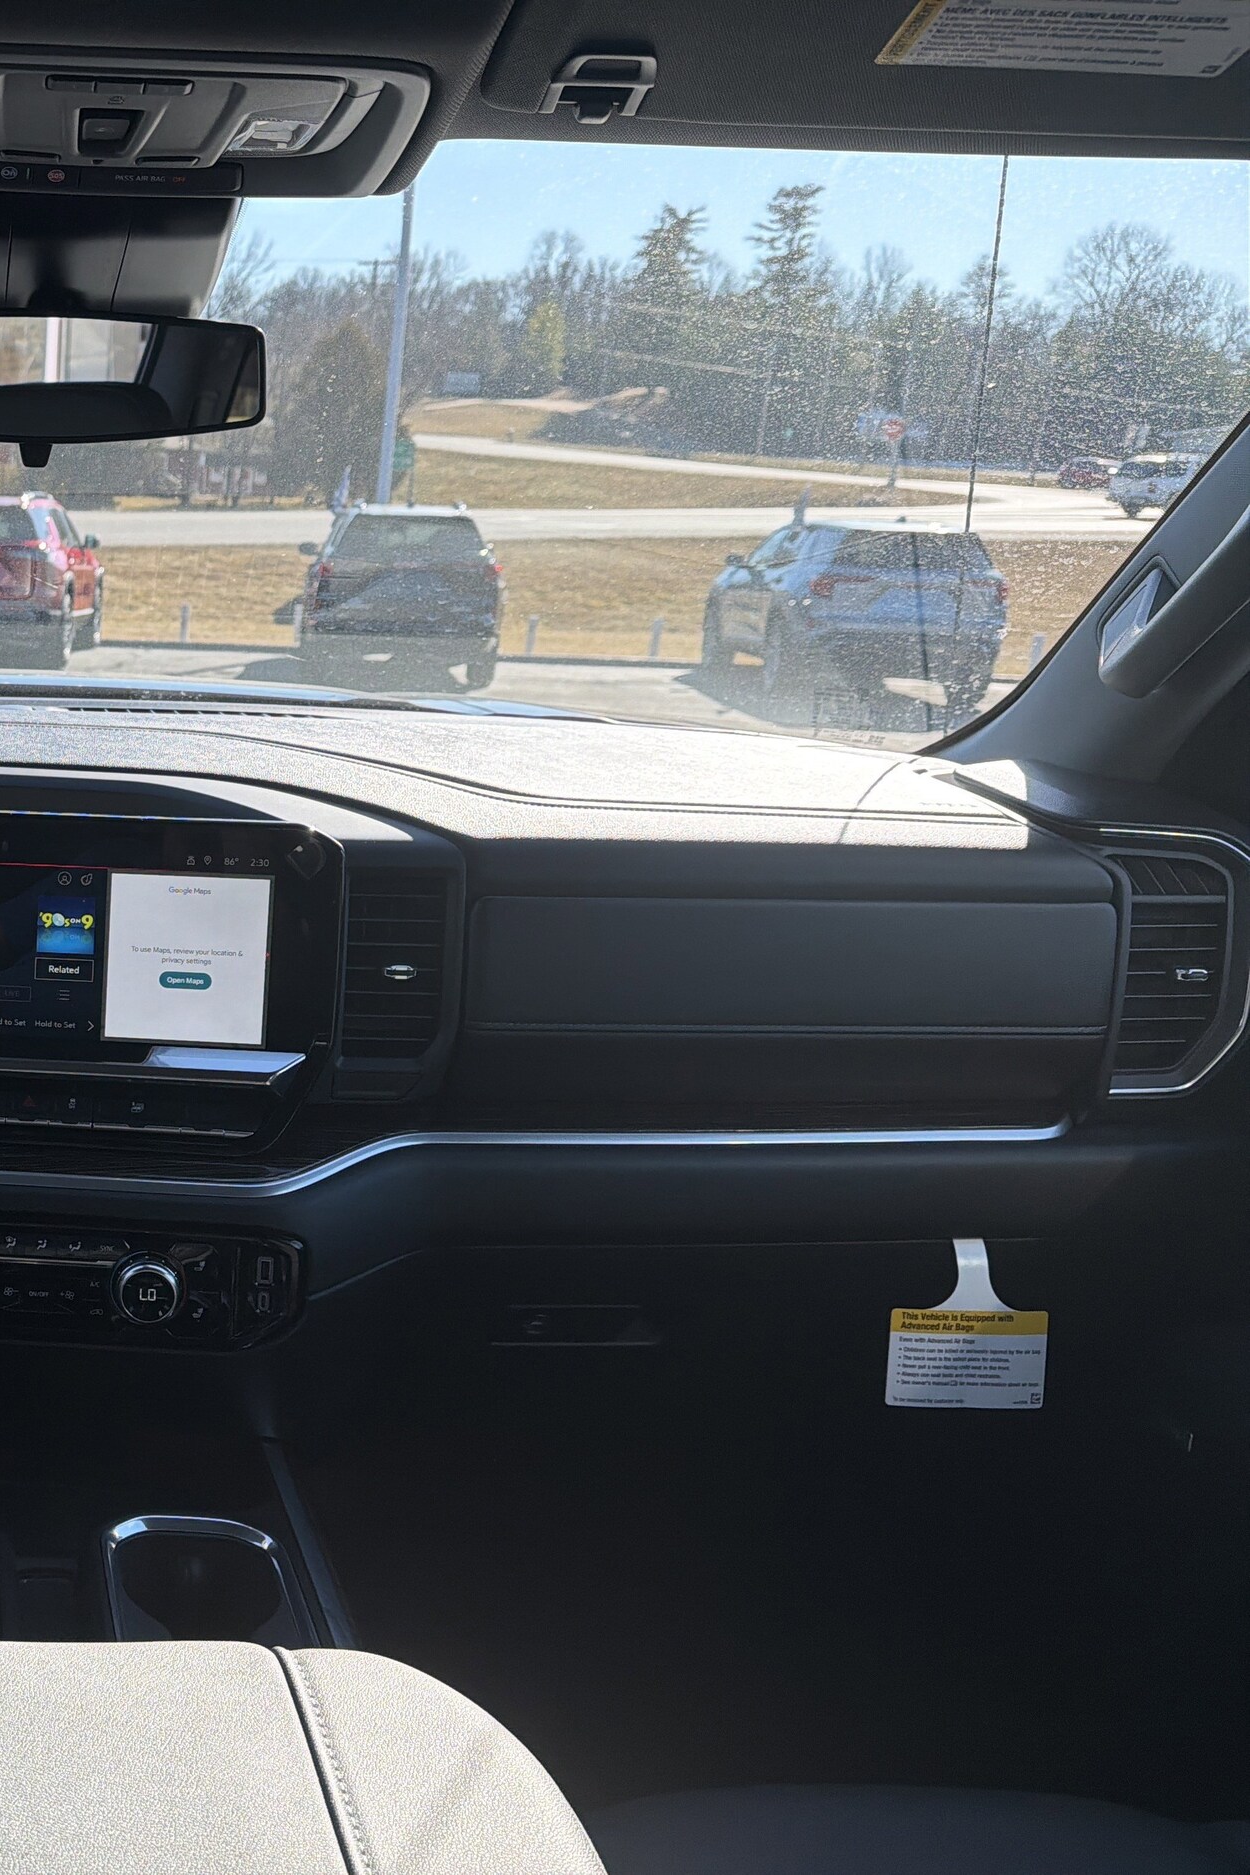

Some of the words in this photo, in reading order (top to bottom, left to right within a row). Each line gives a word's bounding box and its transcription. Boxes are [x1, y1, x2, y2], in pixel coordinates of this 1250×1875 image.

[250, 858, 270, 867] 2:30
[168, 886, 193, 896] Google
[81, 914, 94, 930] 9
[153, 946, 172, 954] Maps,
[211, 949, 237, 957] location
[161, 957, 185, 965] privacy
[186, 958, 212, 966] settings
[48, 965, 80, 974] Related
[166, 976, 185, 985] Open
[186, 977, 204, 985] Maps
[14, 1019, 26, 1027] Set
[34, 1020, 55, 1028] Hold
[64, 1021, 76, 1030] Set
[139, 1288, 157, 1302] LO
[902, 1312, 919, 1320] This
[921, 1312, 949, 1321] Vehicle
[960, 1314, 996, 1324] Equipped
[901, 1322, 940, 1330] Advanced
[955, 1323, 974, 1332] Bags
